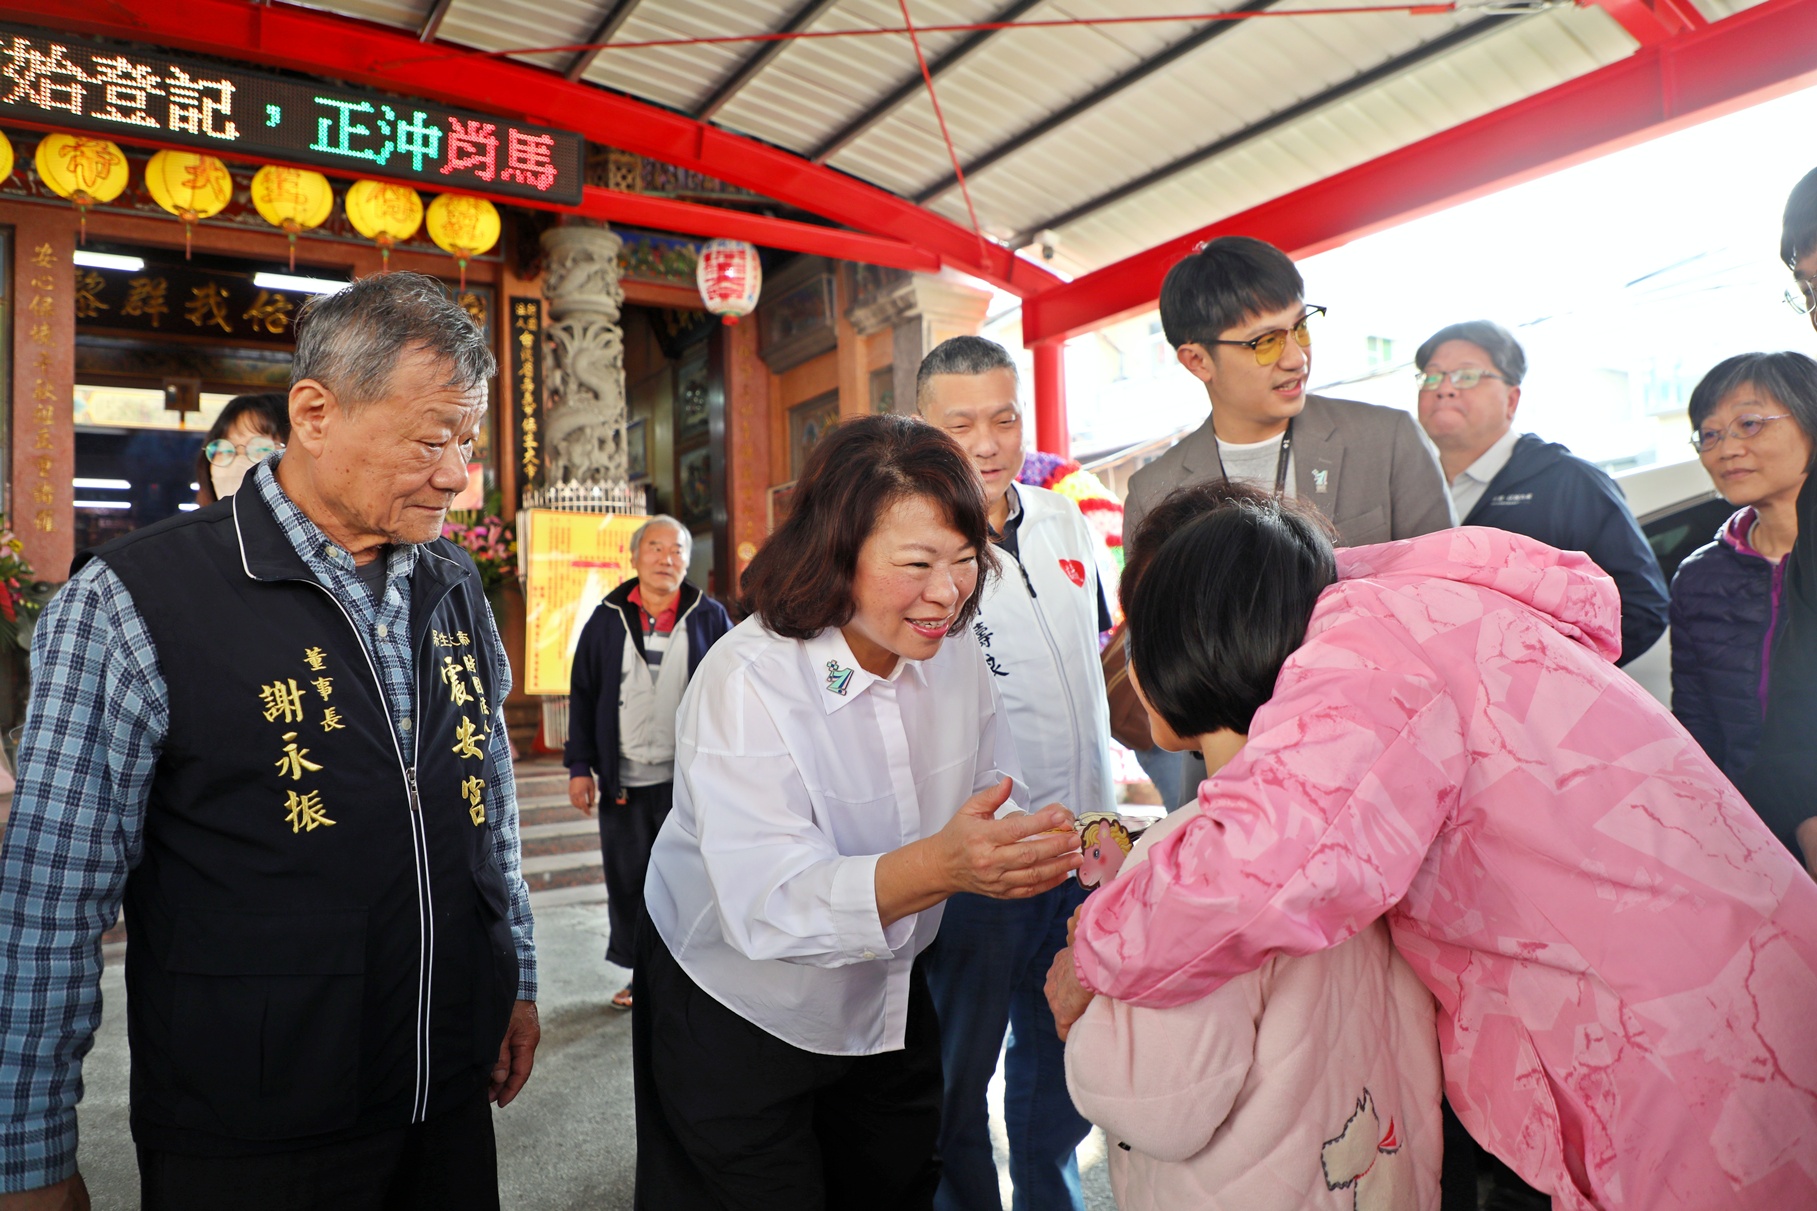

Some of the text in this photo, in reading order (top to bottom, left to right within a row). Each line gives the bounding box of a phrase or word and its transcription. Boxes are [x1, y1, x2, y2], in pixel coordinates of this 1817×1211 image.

[303, 646, 346, 732] 董事長
[973, 606, 1010, 677] 壽良
[258, 677, 337, 834] 謝永振
[440, 655, 486, 827] 震安宮
